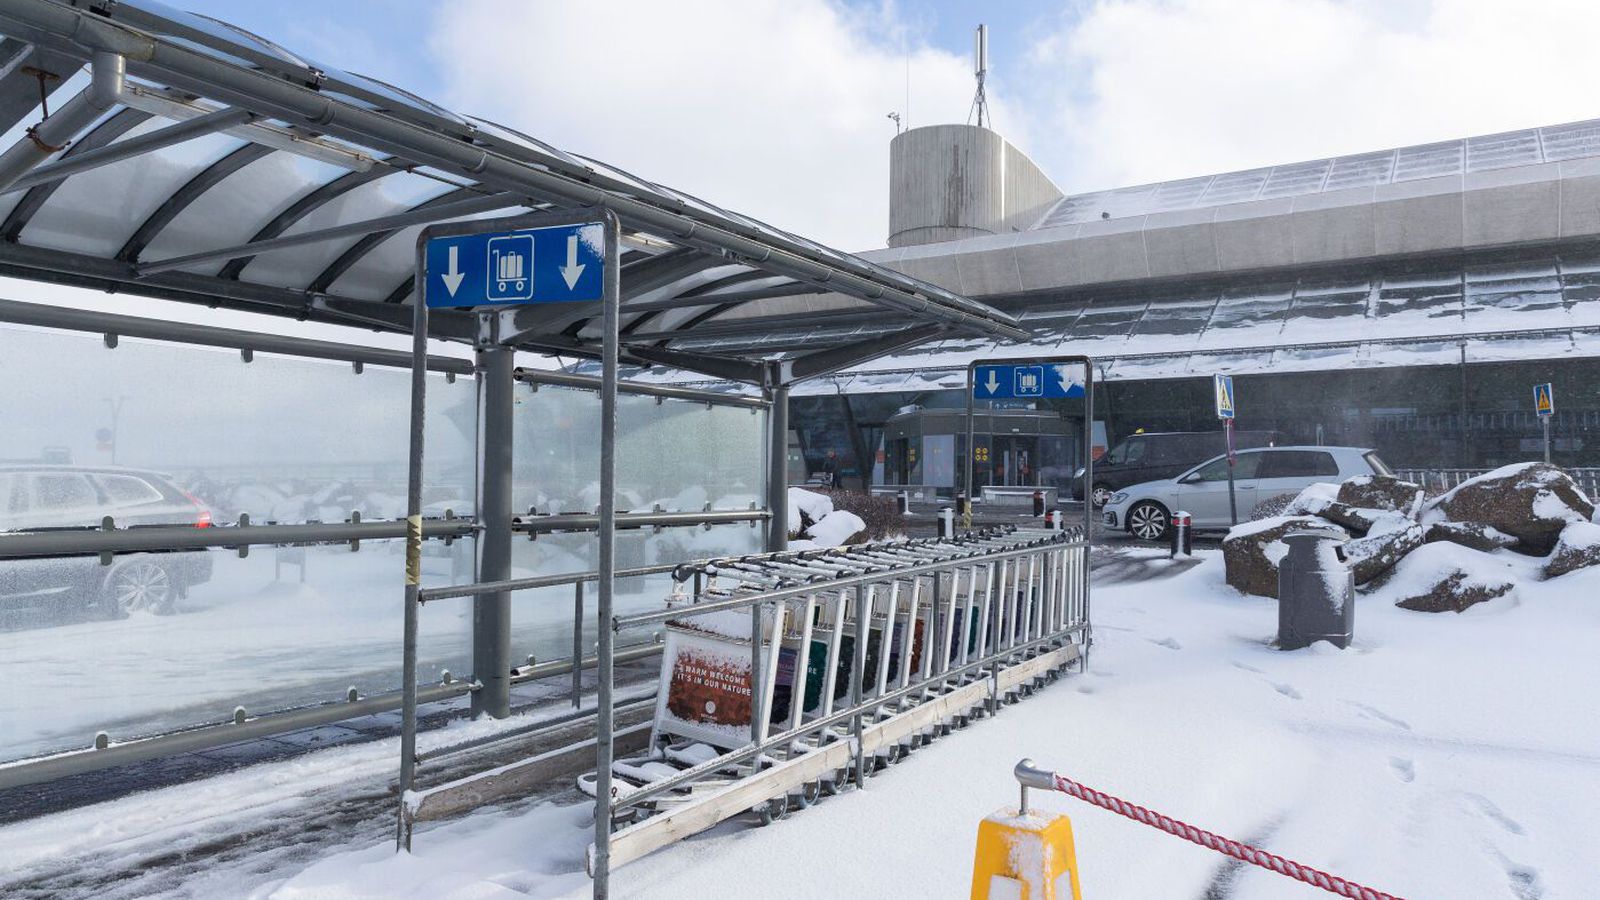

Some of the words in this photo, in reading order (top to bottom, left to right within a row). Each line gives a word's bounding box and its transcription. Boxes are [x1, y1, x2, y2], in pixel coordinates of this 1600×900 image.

[677, 673, 692, 682] IT'S
[704, 678, 719, 688] OUR
[722, 683, 752, 696] NATURE
[685, 665, 707, 676] WARM
[710, 670, 745, 685] WELCOME
